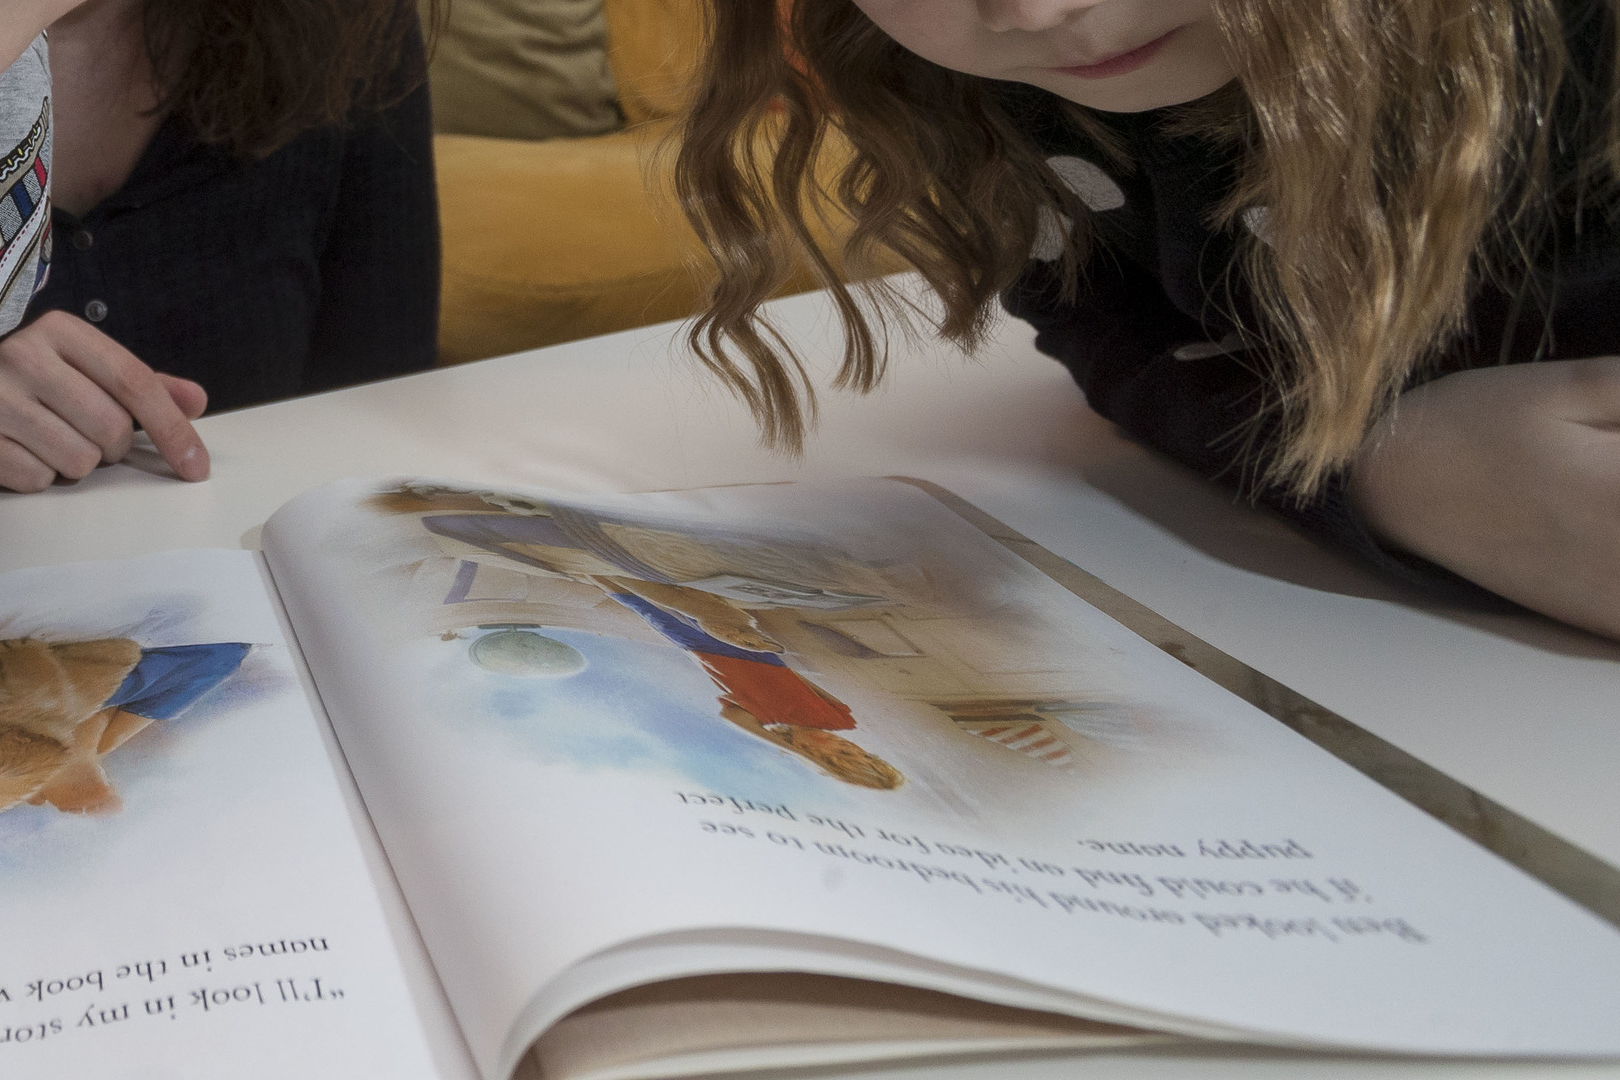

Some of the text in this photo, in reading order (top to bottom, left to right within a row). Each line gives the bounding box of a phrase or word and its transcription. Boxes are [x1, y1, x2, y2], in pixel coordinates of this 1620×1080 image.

[675, 790, 1373, 904] if he could find an idea for the perfect
[1077, 837, 1314, 860] puppy name.
[699, 820, 1430, 944] Ben looked around his bedroom to see
[180, 949, 211, 972] in
[223, 937, 329, 959] names
[116, 959, 167, 983] the
[27, 970, 104, 1002] book
[190, 982, 265, 1012] look
[276, 977, 345, 1003] "I'll
[77, 1003, 130, 1027] my
[144, 995, 176, 1021] in
